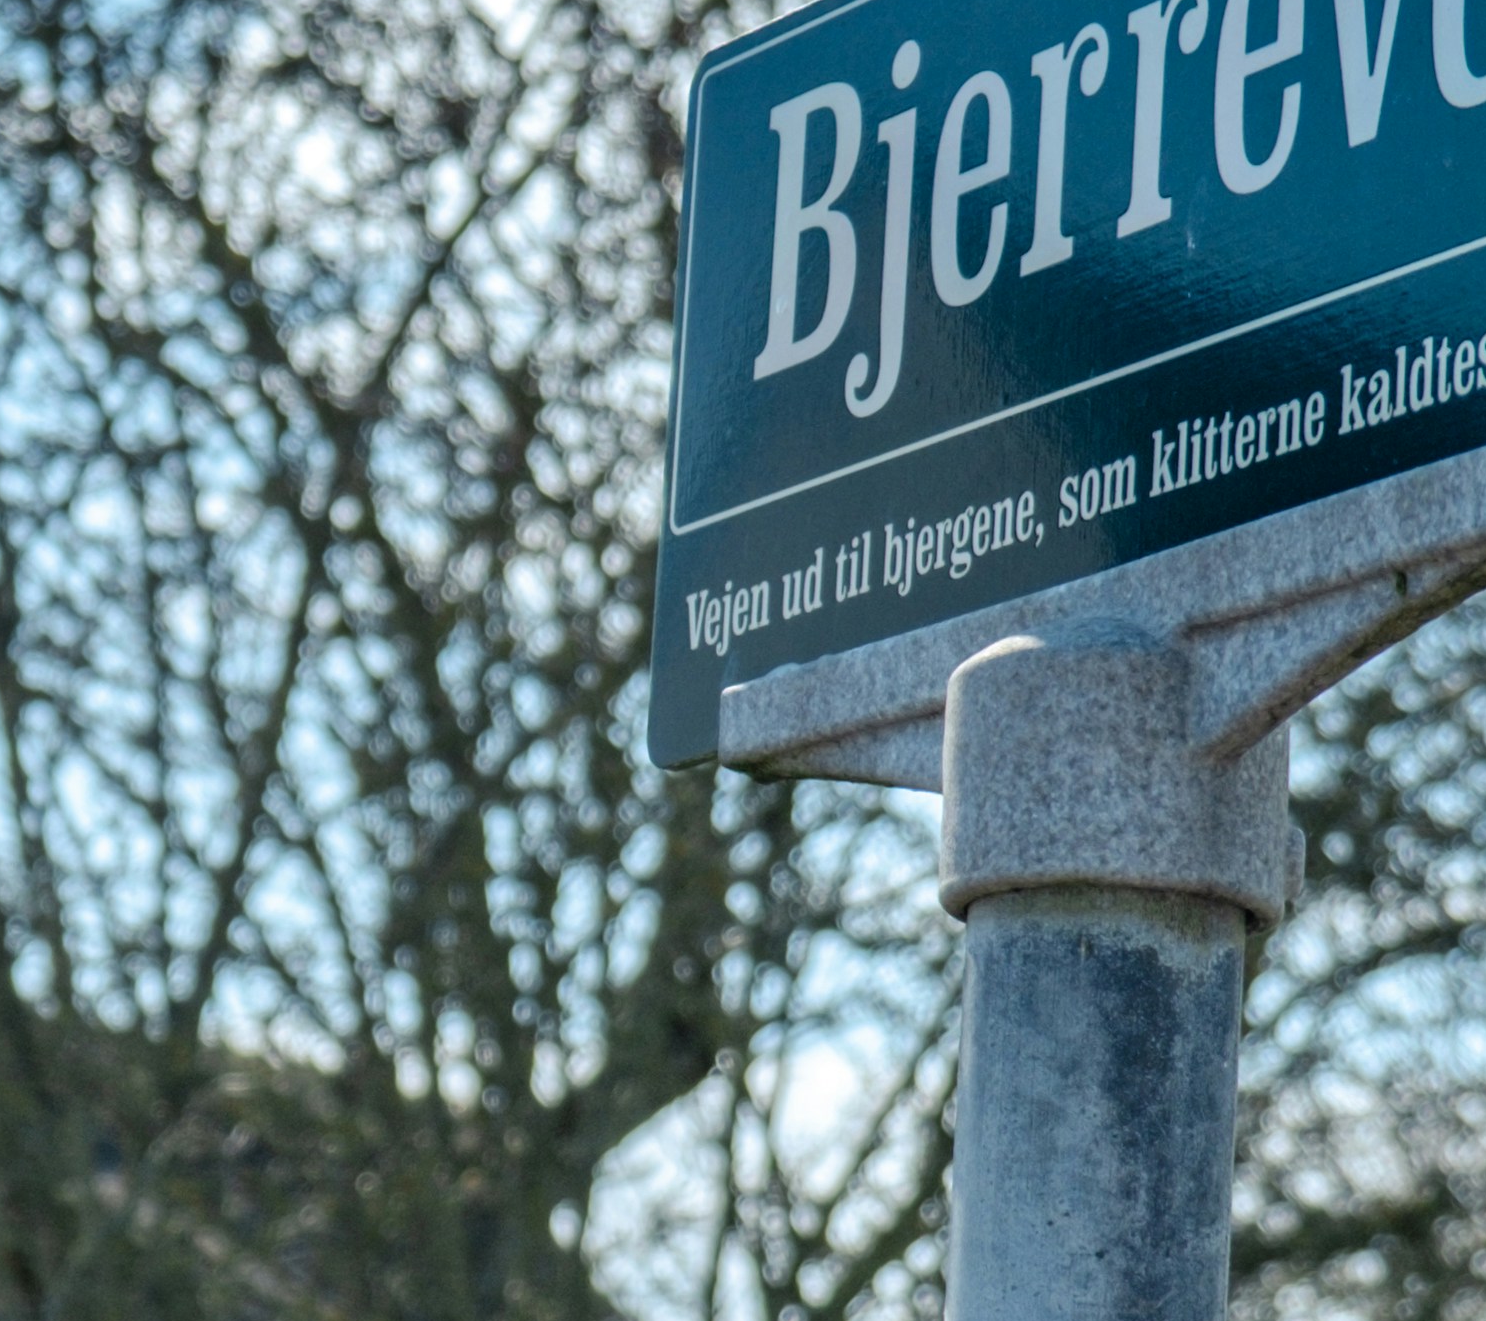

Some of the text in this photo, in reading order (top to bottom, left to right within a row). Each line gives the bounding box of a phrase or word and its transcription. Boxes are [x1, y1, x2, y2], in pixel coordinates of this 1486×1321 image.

[685, 580, 770, 658] Vejen
[781, 547, 824, 621] ud
[834, 530, 872, 604] til
[882, 489, 1046, 598] bjergene,
[1057, 455, 1137, 528] som
[1148, 392, 1325, 498] klitterne
